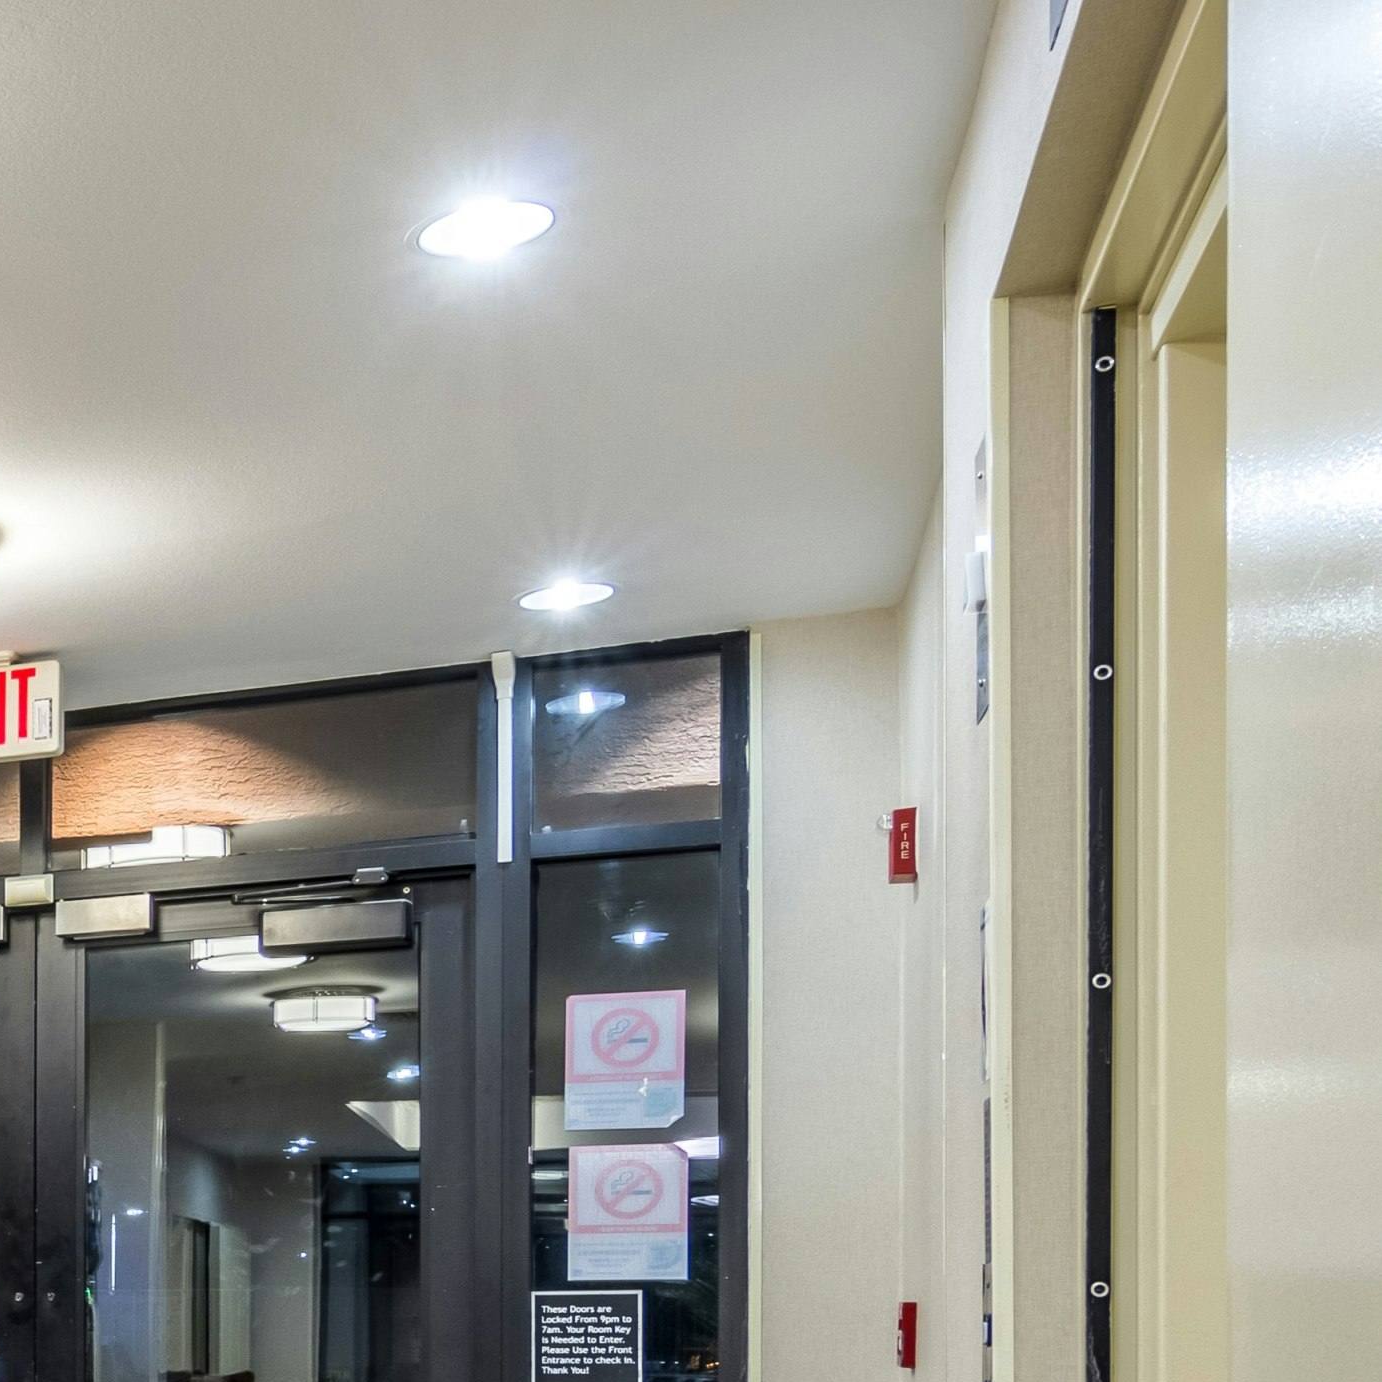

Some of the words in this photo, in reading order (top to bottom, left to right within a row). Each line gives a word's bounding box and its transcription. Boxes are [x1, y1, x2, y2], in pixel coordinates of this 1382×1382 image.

[900, 822, 910, 859] FIRE
[541, 1305, 567, 1313] These
[569, 1305, 594, 1313] Doors
[541, 1316, 572, 1324] Locked
[599, 1316, 620, 1325] 9pm
[614, 1326, 631, 1335] Key
[541, 1336, 549, 1344] is
[551, 1336, 584, 1344] Needed
[599, 1336, 625, 1344] Enter.
[541, 1346, 570, 1354] Please
[572, 1346, 589, 1354] Use
[591, 1346, 606, 1354] the
[608, 1346, 633, 1354] Front
[541, 1356, 581, 1364] Entrance
[595, 1356, 621, 1364] check
[624, 1356, 635, 1364] in.
[541, 1366, 569, 1374] Thank
[571, 1366, 589, 1374] You!
